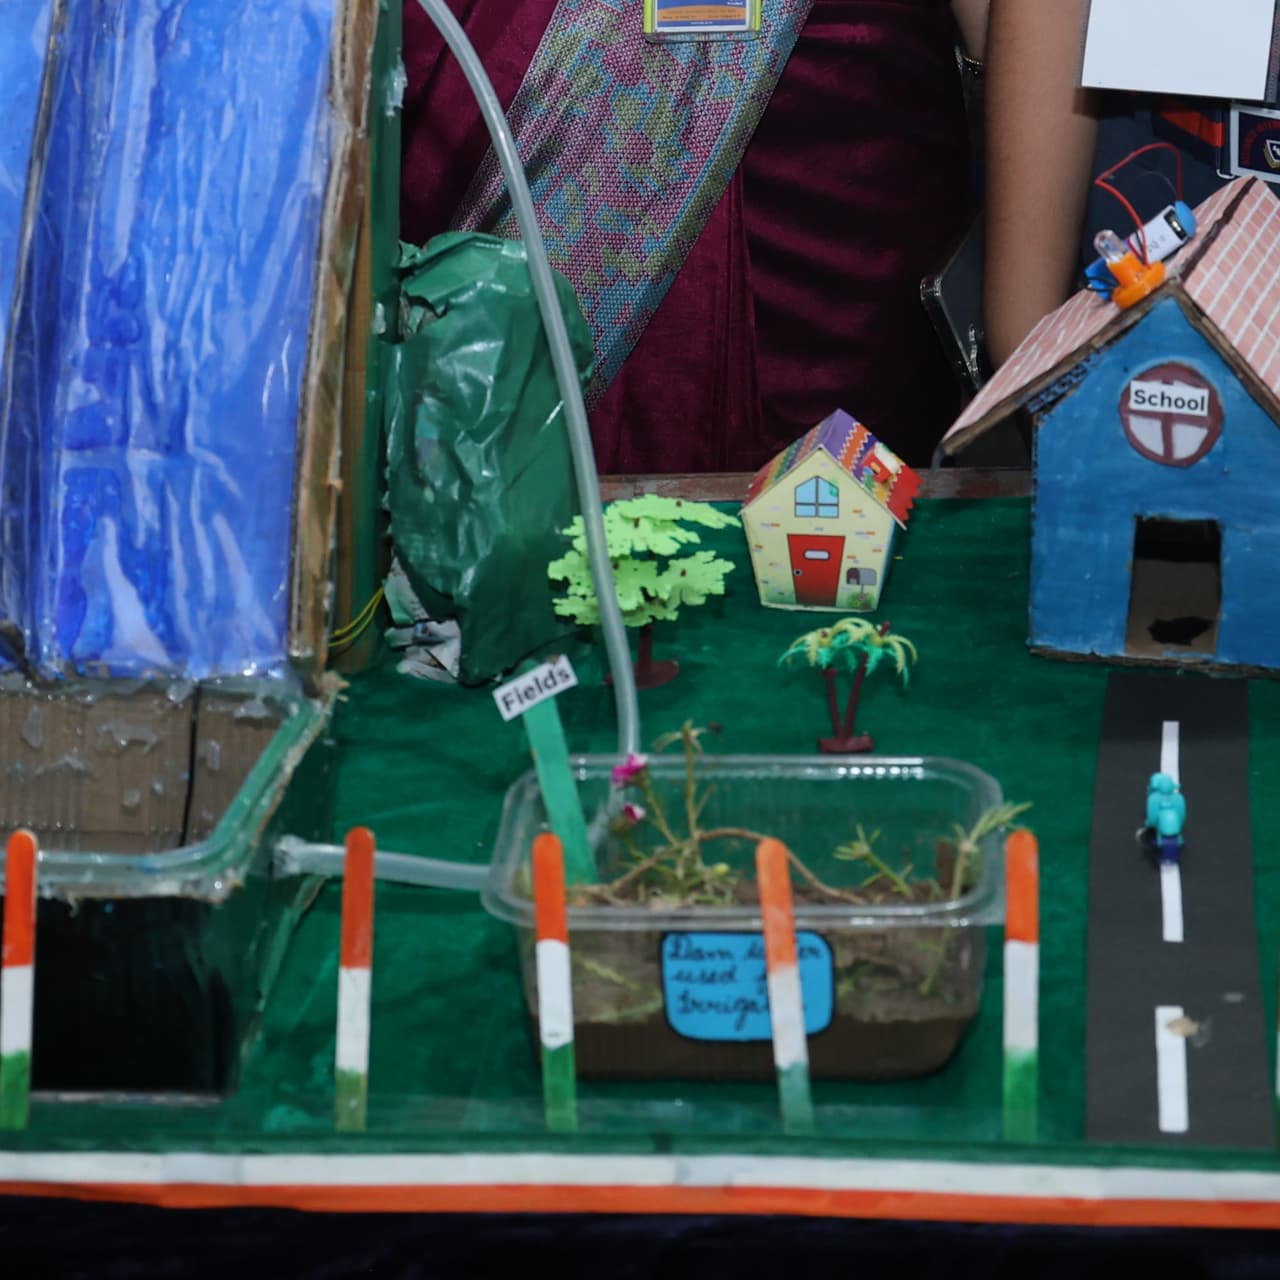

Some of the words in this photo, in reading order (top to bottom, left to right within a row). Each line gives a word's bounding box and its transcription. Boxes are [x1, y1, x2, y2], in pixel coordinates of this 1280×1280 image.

[1134, 389, 1205, 412] School
[501, 669, 571, 712] Fields
[670, 933, 734, 960] Dam
[673, 964, 737, 984] used
